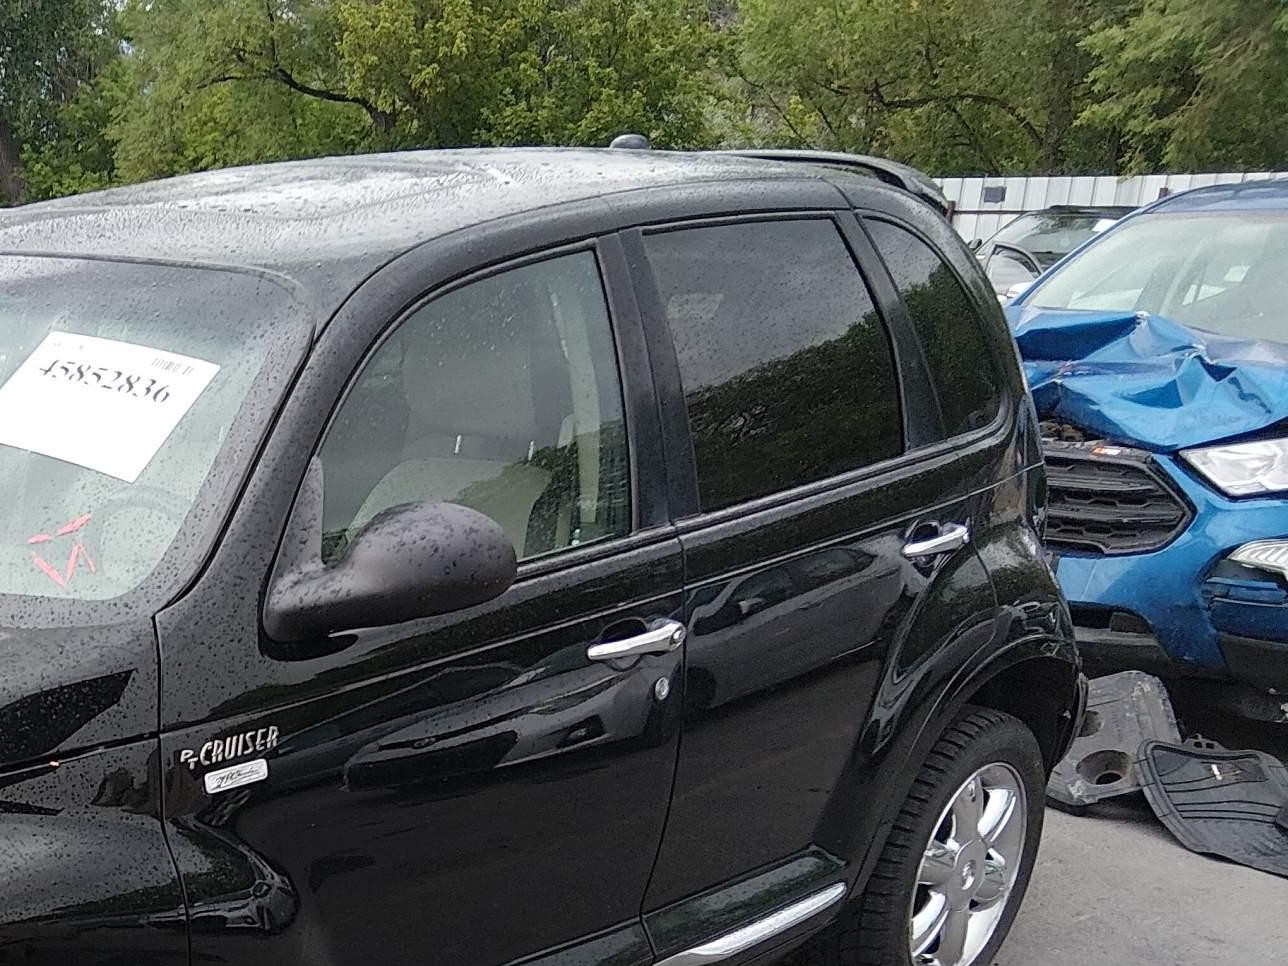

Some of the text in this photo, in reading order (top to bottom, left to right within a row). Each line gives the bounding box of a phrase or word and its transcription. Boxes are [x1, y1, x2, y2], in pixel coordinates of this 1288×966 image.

[39, 359, 171, 403] 45852836
[180, 725, 280, 770] PT CRUISER
